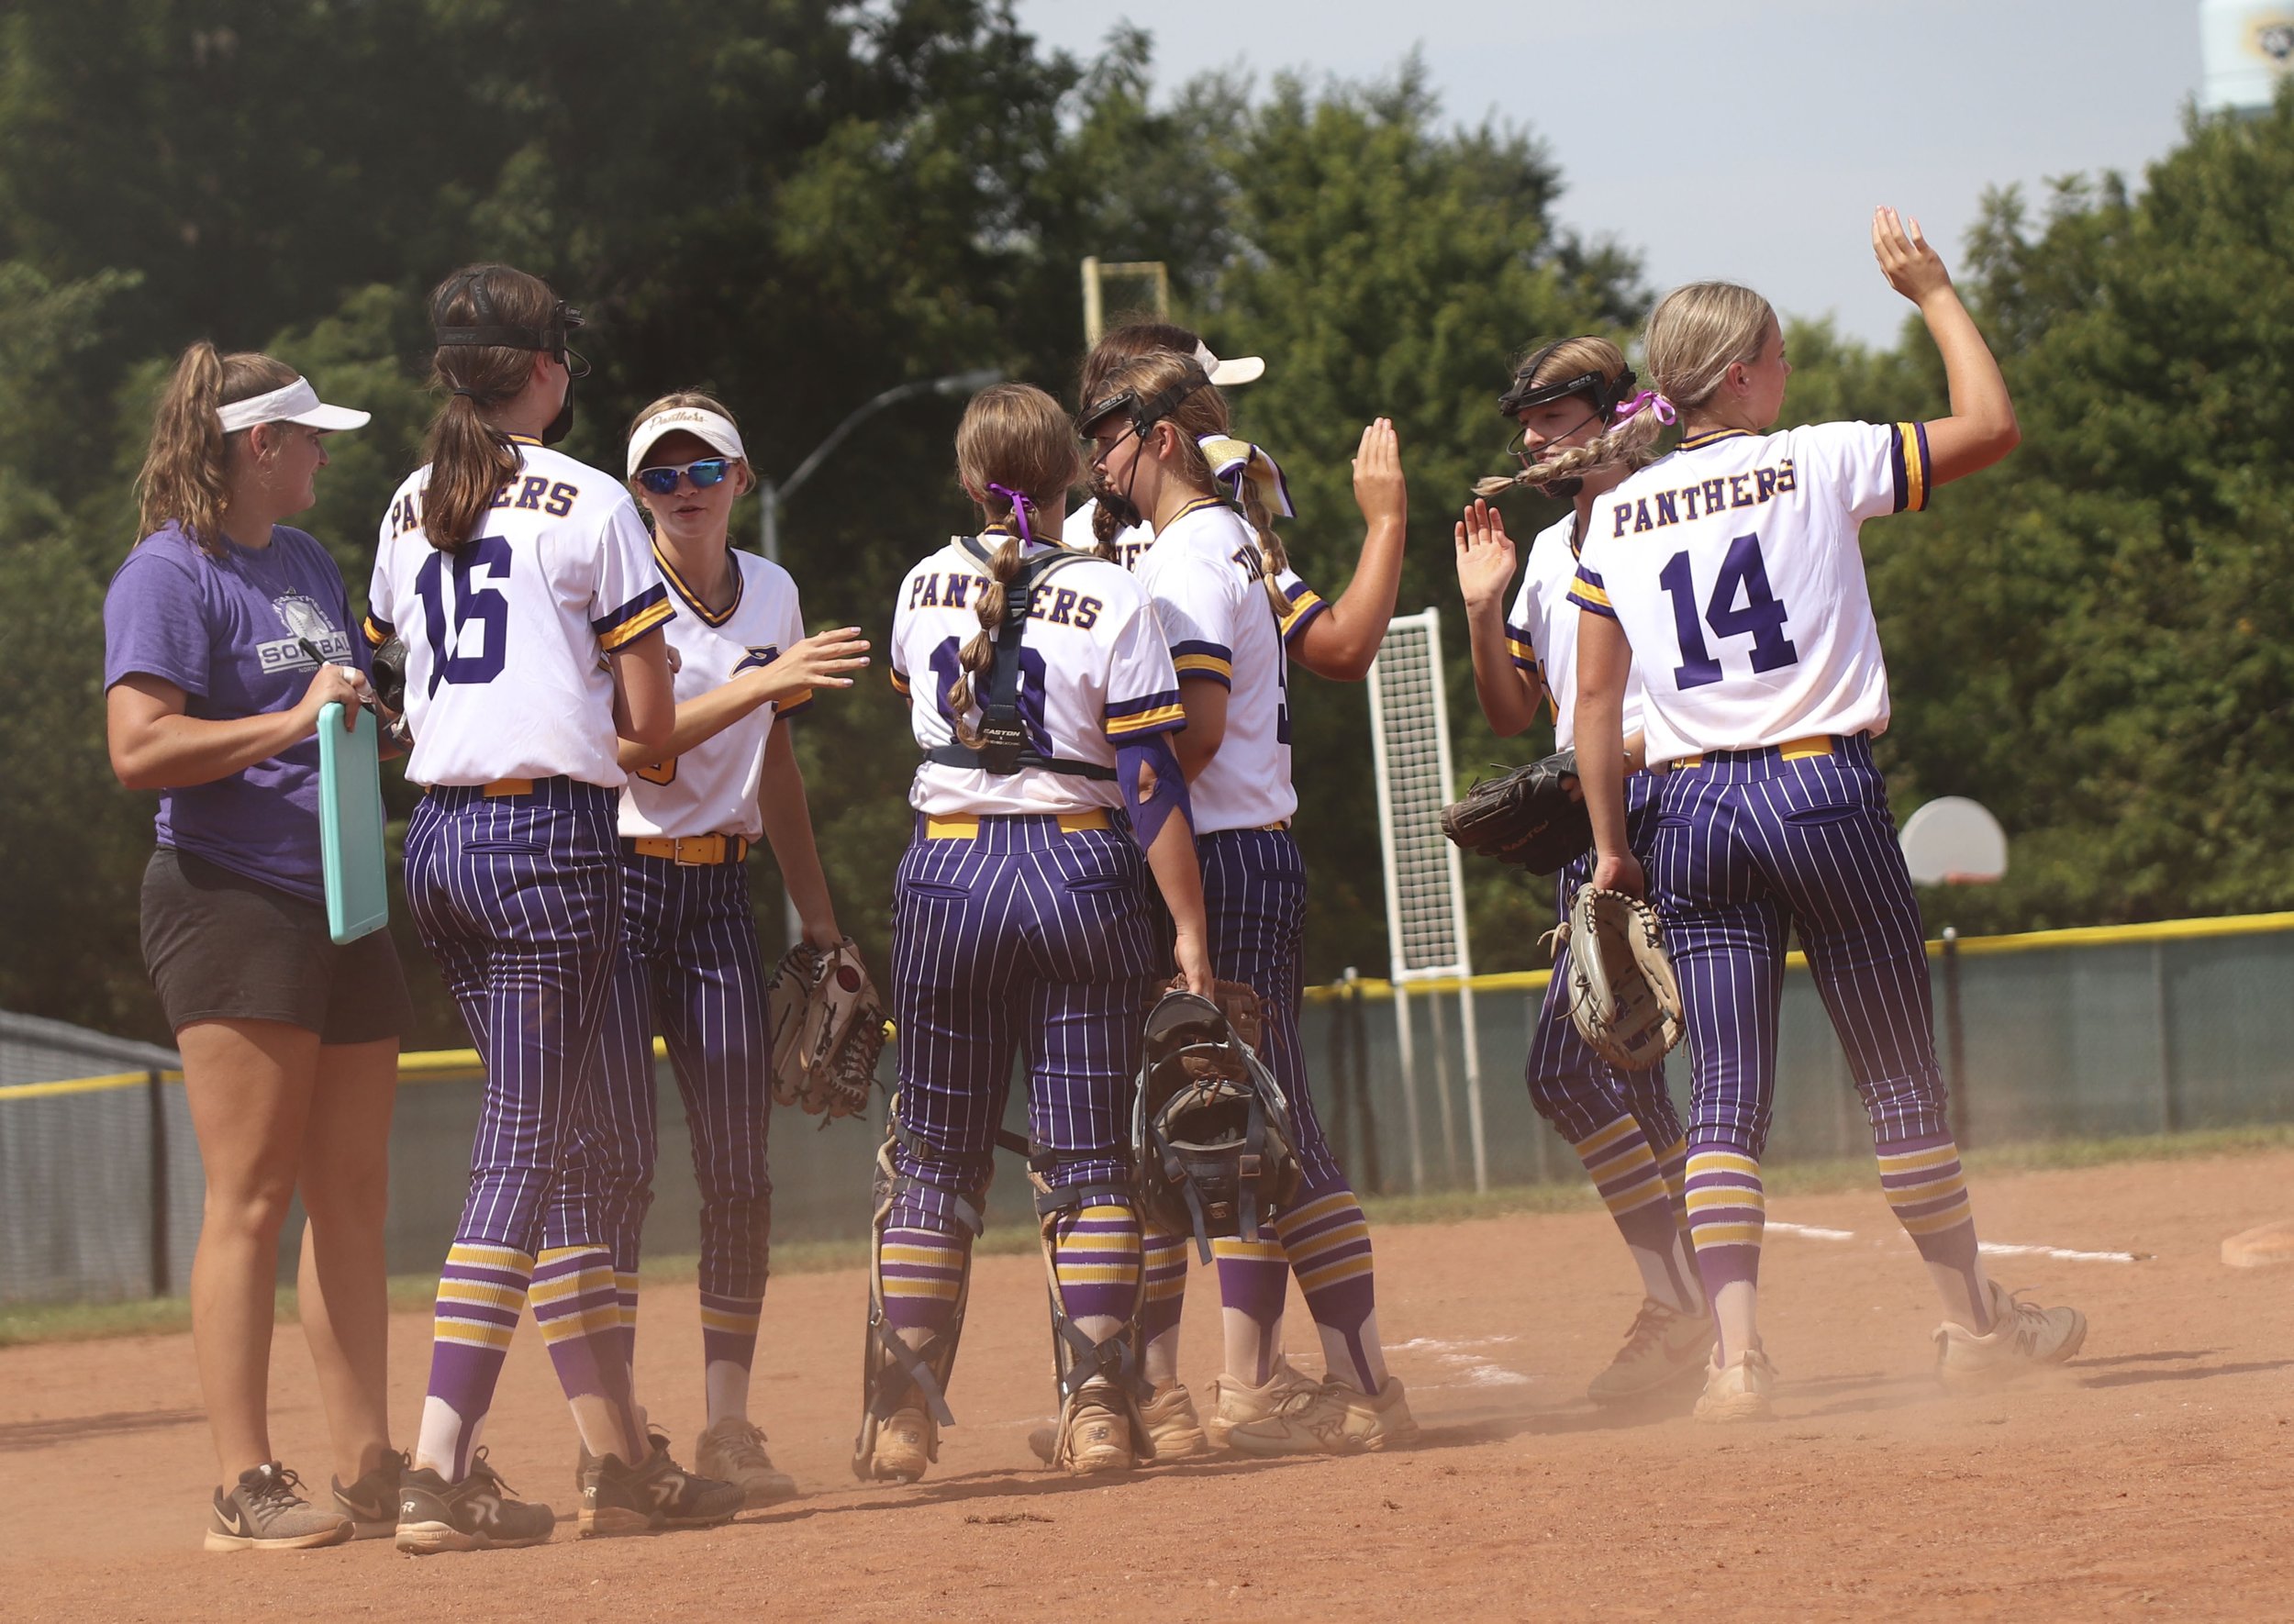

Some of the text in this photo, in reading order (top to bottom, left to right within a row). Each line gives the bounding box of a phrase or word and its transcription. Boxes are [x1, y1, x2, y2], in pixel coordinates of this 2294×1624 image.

[391, 475, 579, 539] PAERS
[1612, 458, 1796, 539] PANTHERS
[415, 535, 513, 701] 16
[908, 573, 1103, 631] PANTERS
[1659, 531, 1798, 691] 14
[983, 728, 1020, 737] EASTON
